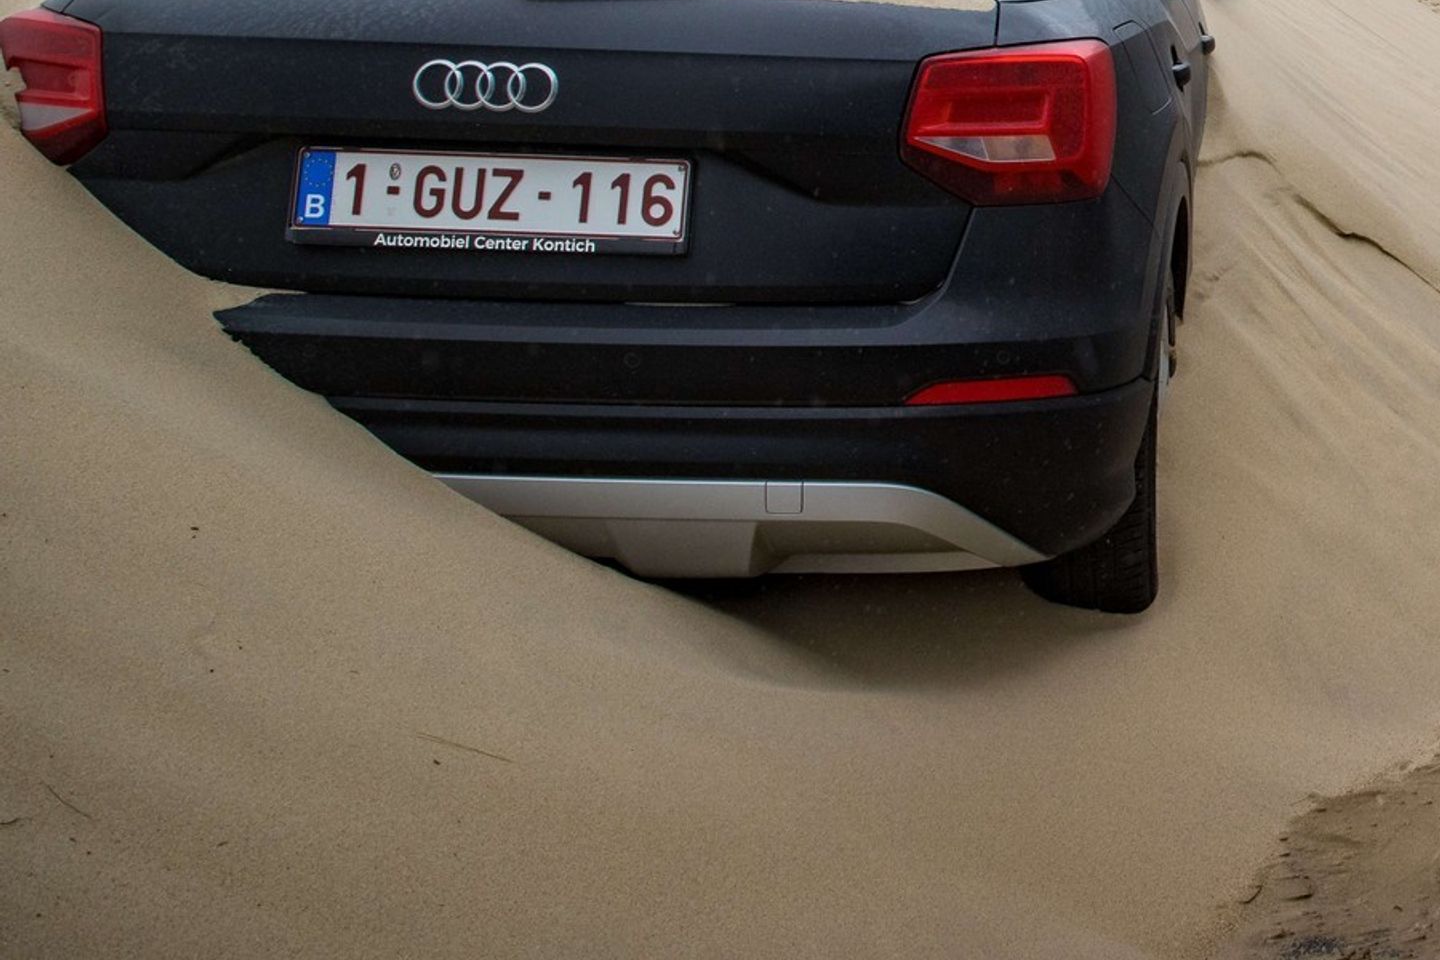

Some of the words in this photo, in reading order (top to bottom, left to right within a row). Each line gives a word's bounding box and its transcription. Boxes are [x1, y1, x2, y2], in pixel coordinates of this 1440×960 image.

[304, 193, 325, 218] B
[374, 233, 470, 249] Automobiel
[474, 237, 529, 252] Center
[533, 238, 595, 253] Kontich
